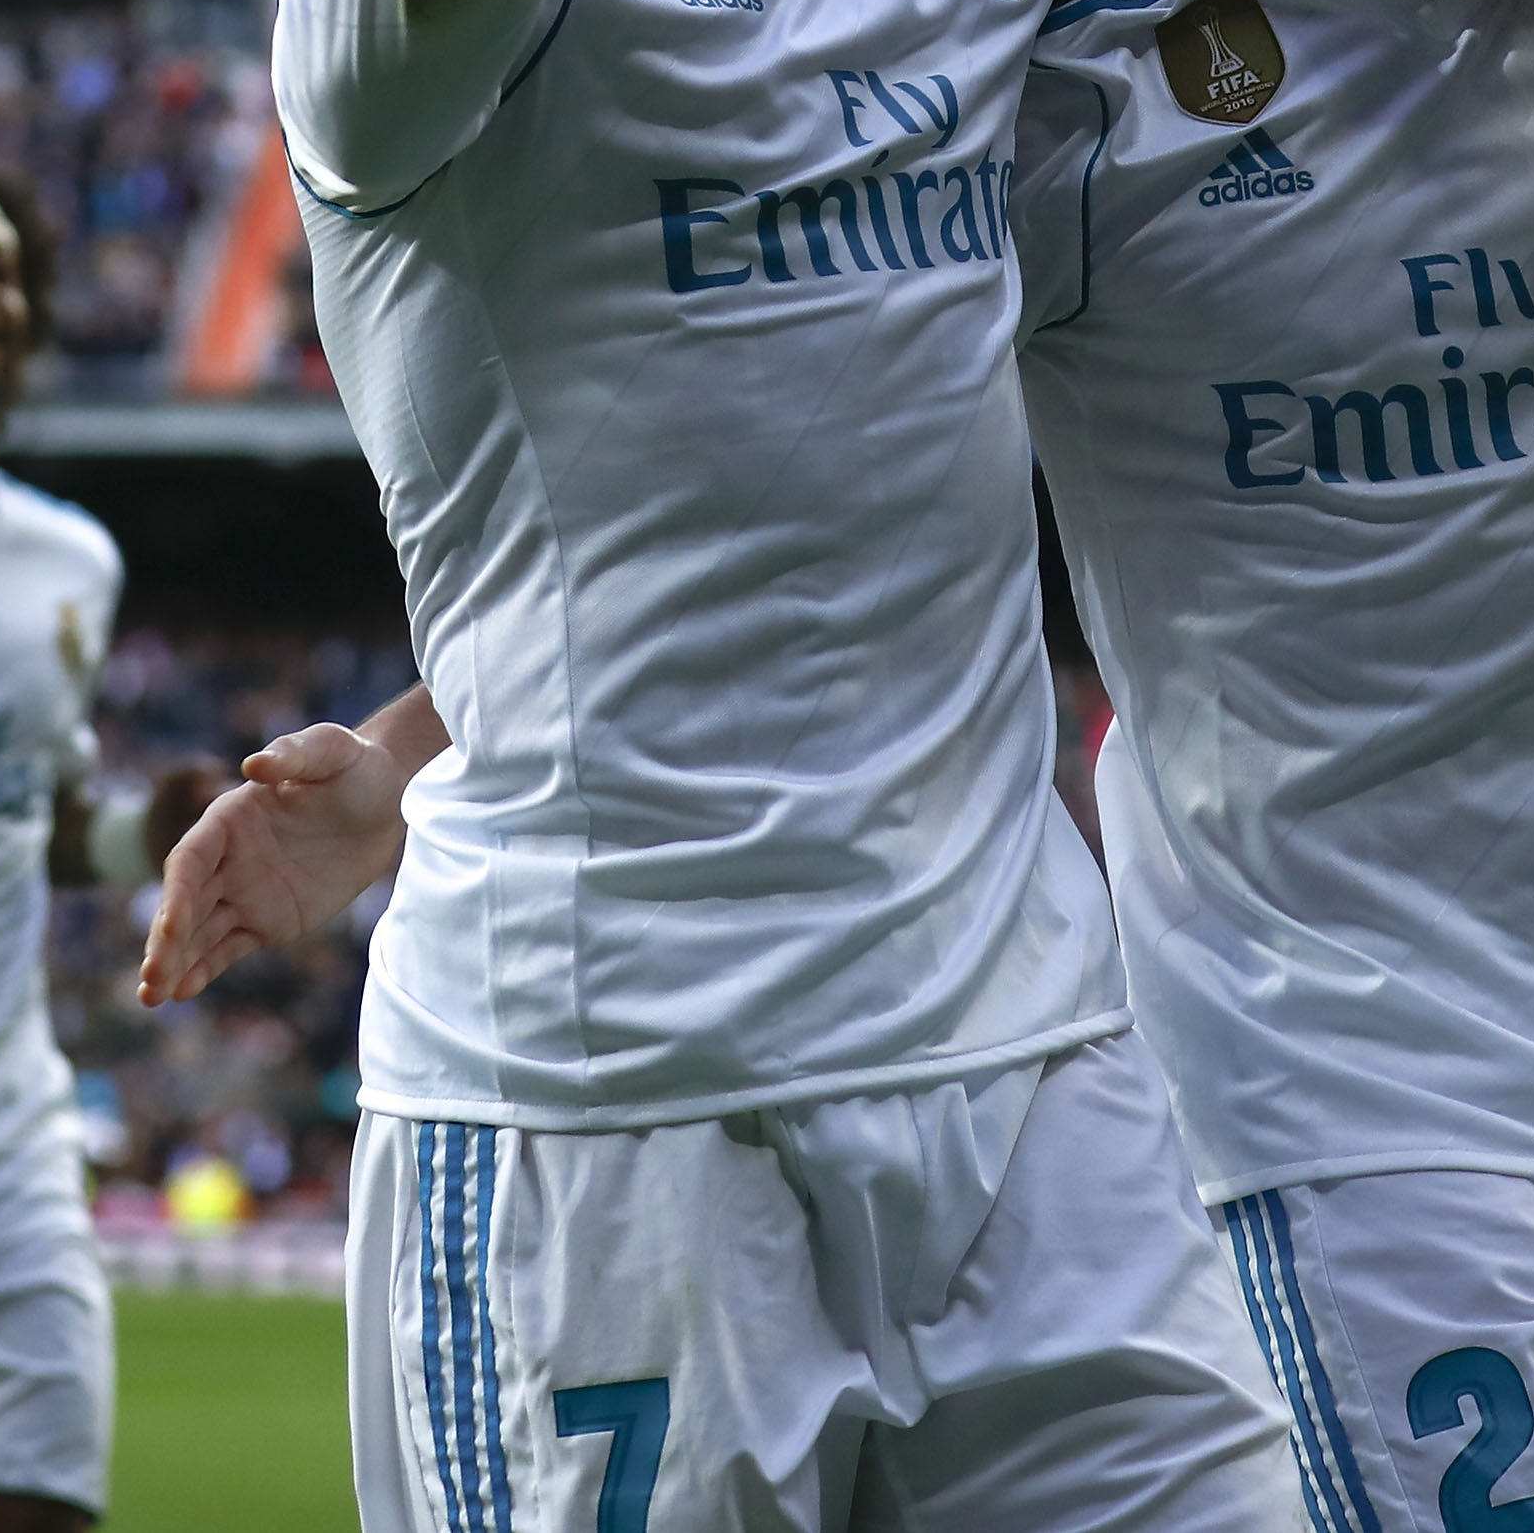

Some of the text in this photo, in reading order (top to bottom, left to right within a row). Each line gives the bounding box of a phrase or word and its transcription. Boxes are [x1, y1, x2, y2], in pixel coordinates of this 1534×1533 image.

[824, 70, 959, 148] Fly
[1207, 70, 1260, 99] FIFA
[1225, 96, 1255, 112] 2016
[1198, 169, 1315, 207] adidas
[652, 142, 1014, 294] Emirate
[552, 1376, 671, 1533] 7
